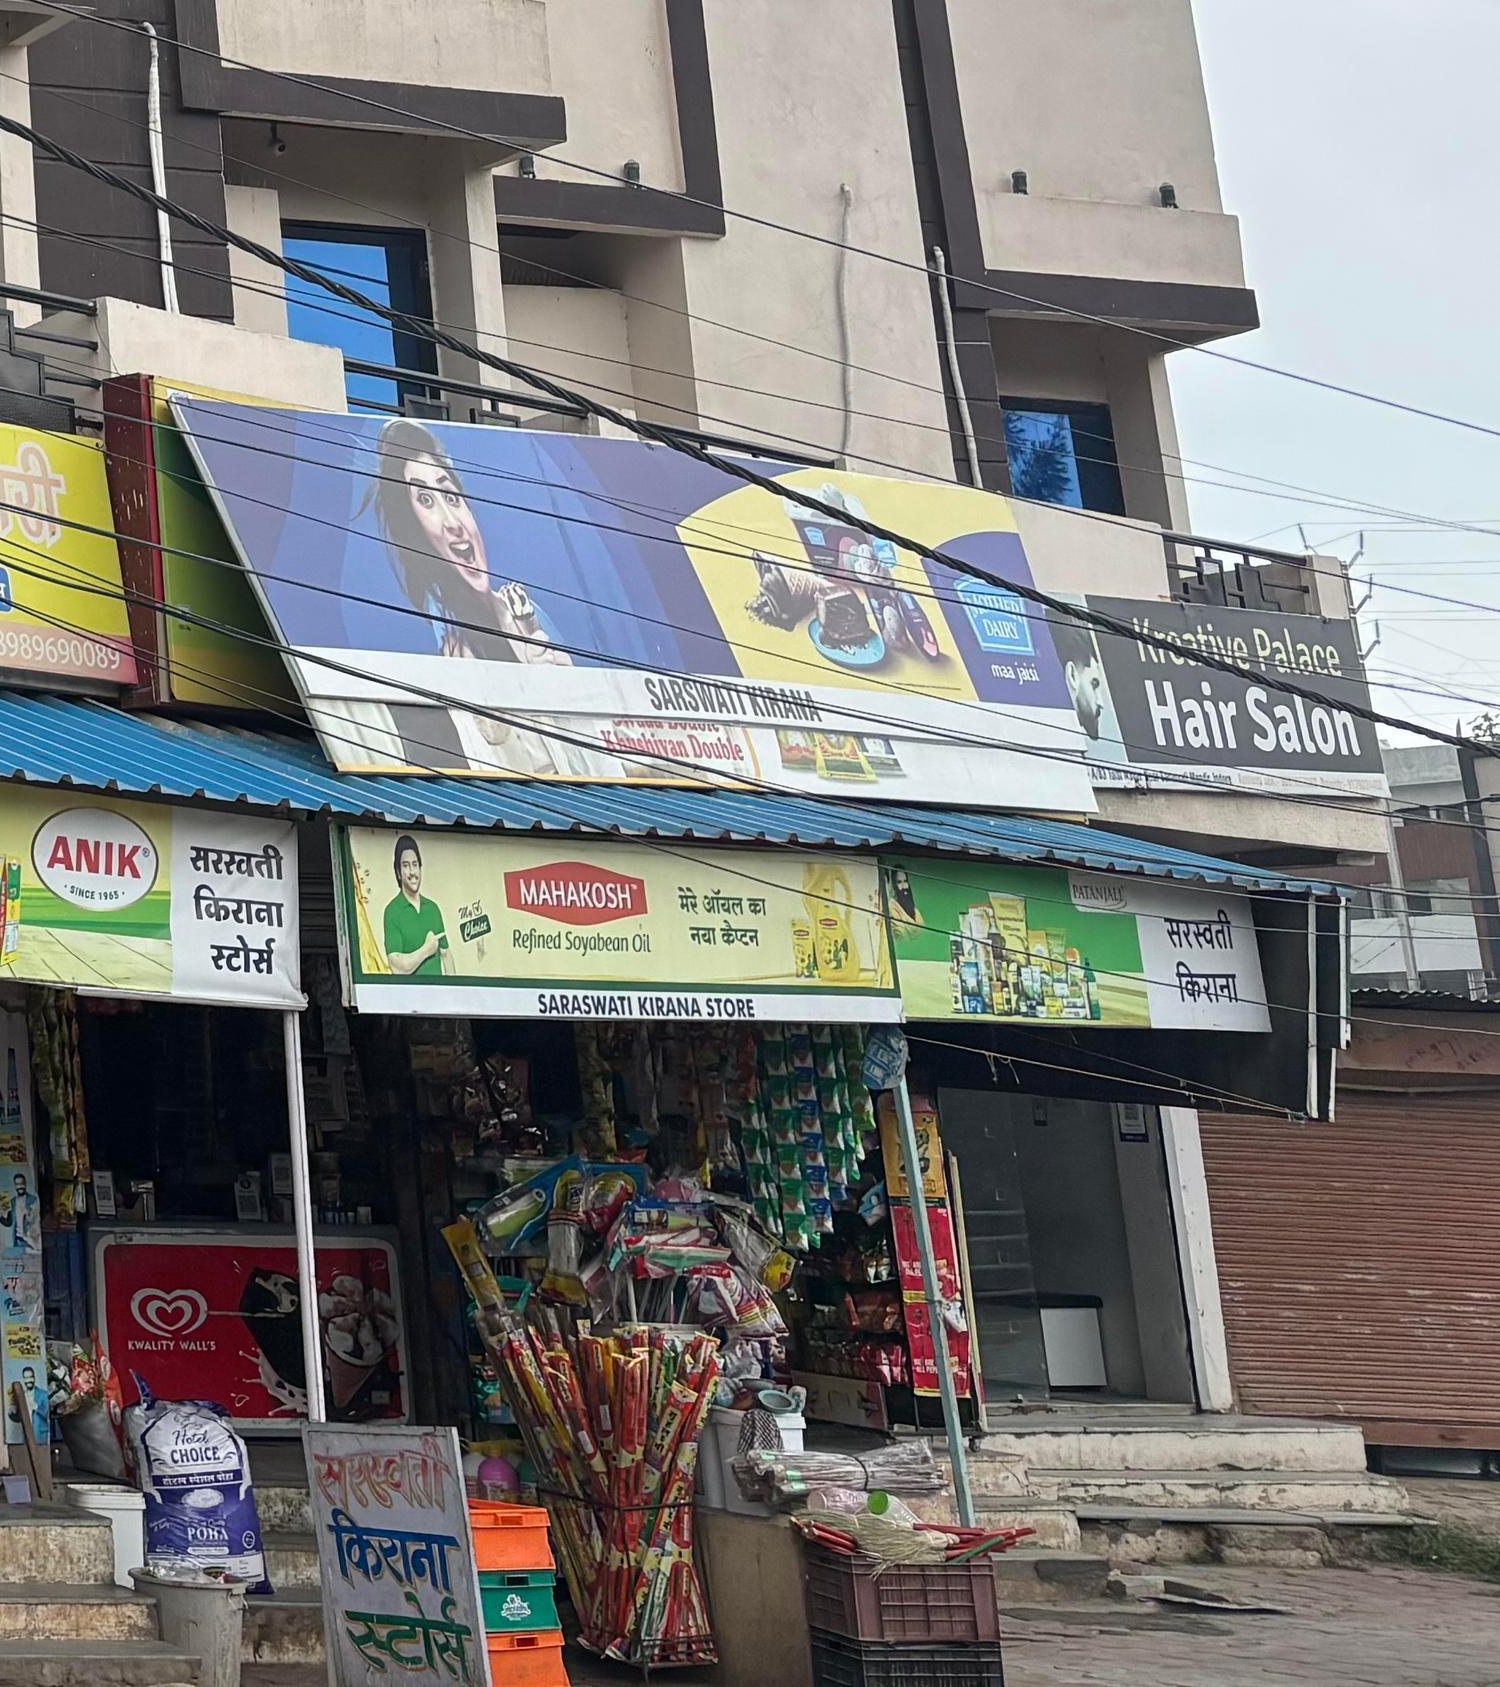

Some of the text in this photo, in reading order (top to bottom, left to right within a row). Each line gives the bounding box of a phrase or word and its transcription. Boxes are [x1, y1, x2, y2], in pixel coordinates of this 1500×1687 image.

[982, 618, 1020, 640] DAIRY
[1132, 617, 1343, 676] Kreative Palace
[991, 662, 1040, 685] maa jaisi
[644, 677, 823, 723] SARSWATI KIRANA
[1144, 680, 1361, 756] Hair Salon
[688, 734, 744, 761] Double
[47, 835, 142, 879] ANIK
[190, 845, 284, 880] सरस्वती
[69, 885, 120, 900] SINCE 1965
[194, 884, 284, 928] किराना
[519, 879, 632, 909] MAHAKOSH
[679, 886, 766, 916] मेरे ऑयल का
[1072, 883, 1124, 904] PATANJALI
[513, 929, 652, 957] Refined Soyabean Oil
[689, 926, 717, 945] नया
[1164, 909, 1234, 950] सरस्वती
[210, 935, 276, 975] स्टोर्स
[1176, 961, 1240, 1003] किराना
[538, 994, 755, 1018] SARASWATI KIRANA STORE
[128, 1340, 216, 1351] KWALITY WALL'S
[172, 1429, 209, 1446] Hotel
[170, 1445, 221, 1464] CHOICE
[327, 1508, 461, 1594] किराना
